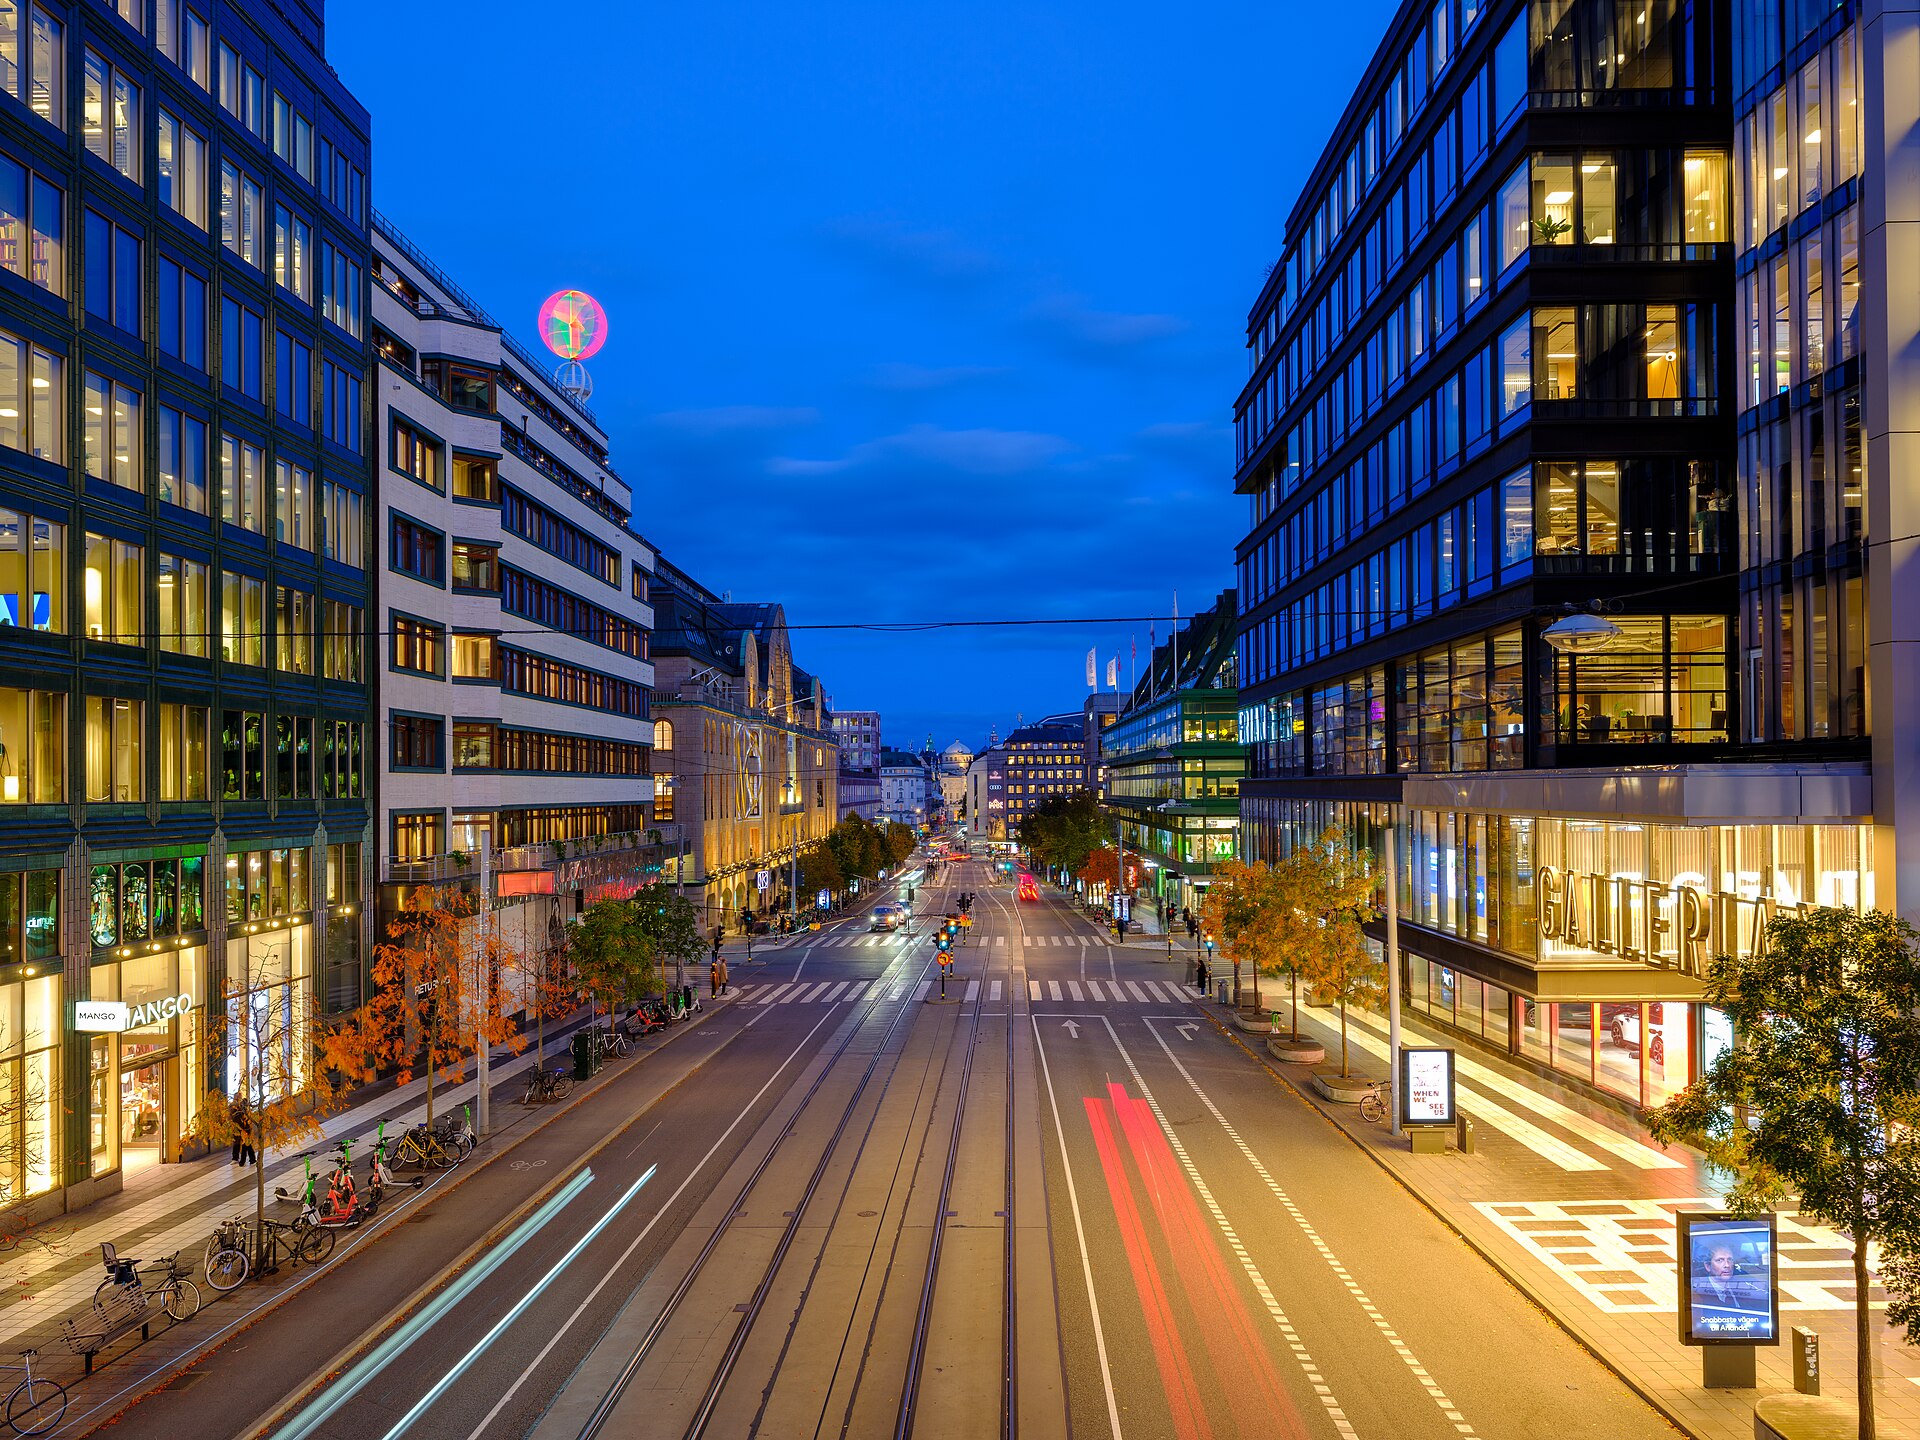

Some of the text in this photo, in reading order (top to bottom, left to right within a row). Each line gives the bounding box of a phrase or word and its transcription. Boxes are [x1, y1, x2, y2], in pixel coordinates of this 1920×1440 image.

[1539, 865, 1818, 981] GALLERIA
[78, 1012, 116, 1021] MANGO
[1738, 1316, 1758, 1324] vägen
